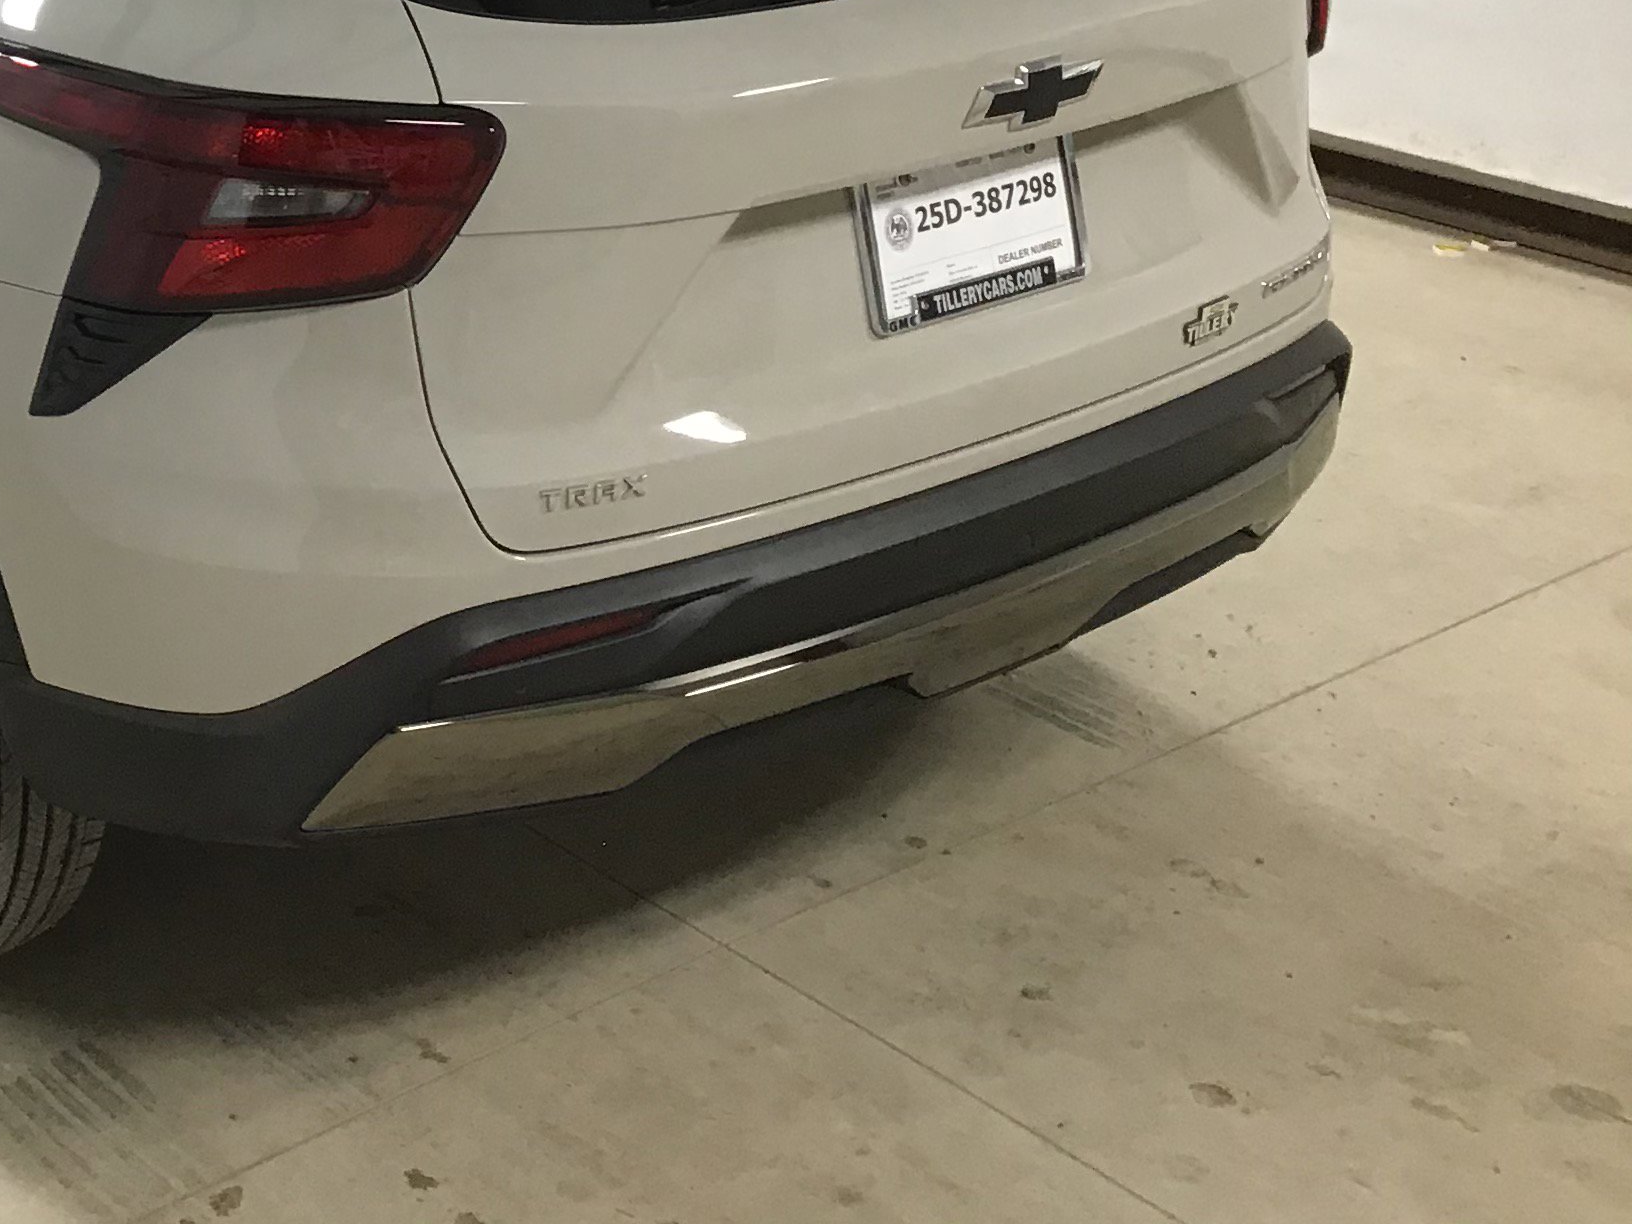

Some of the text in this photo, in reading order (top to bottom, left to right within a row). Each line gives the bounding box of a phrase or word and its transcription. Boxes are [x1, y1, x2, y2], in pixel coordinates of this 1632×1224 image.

[915, 172, 1057, 232] 25D-387298
[998, 238, 1063, 263] DEALER NUMBER
[934, 266, 1043, 314] TILLERYCARS.COM
[538, 473, 649, 513] TRAX
